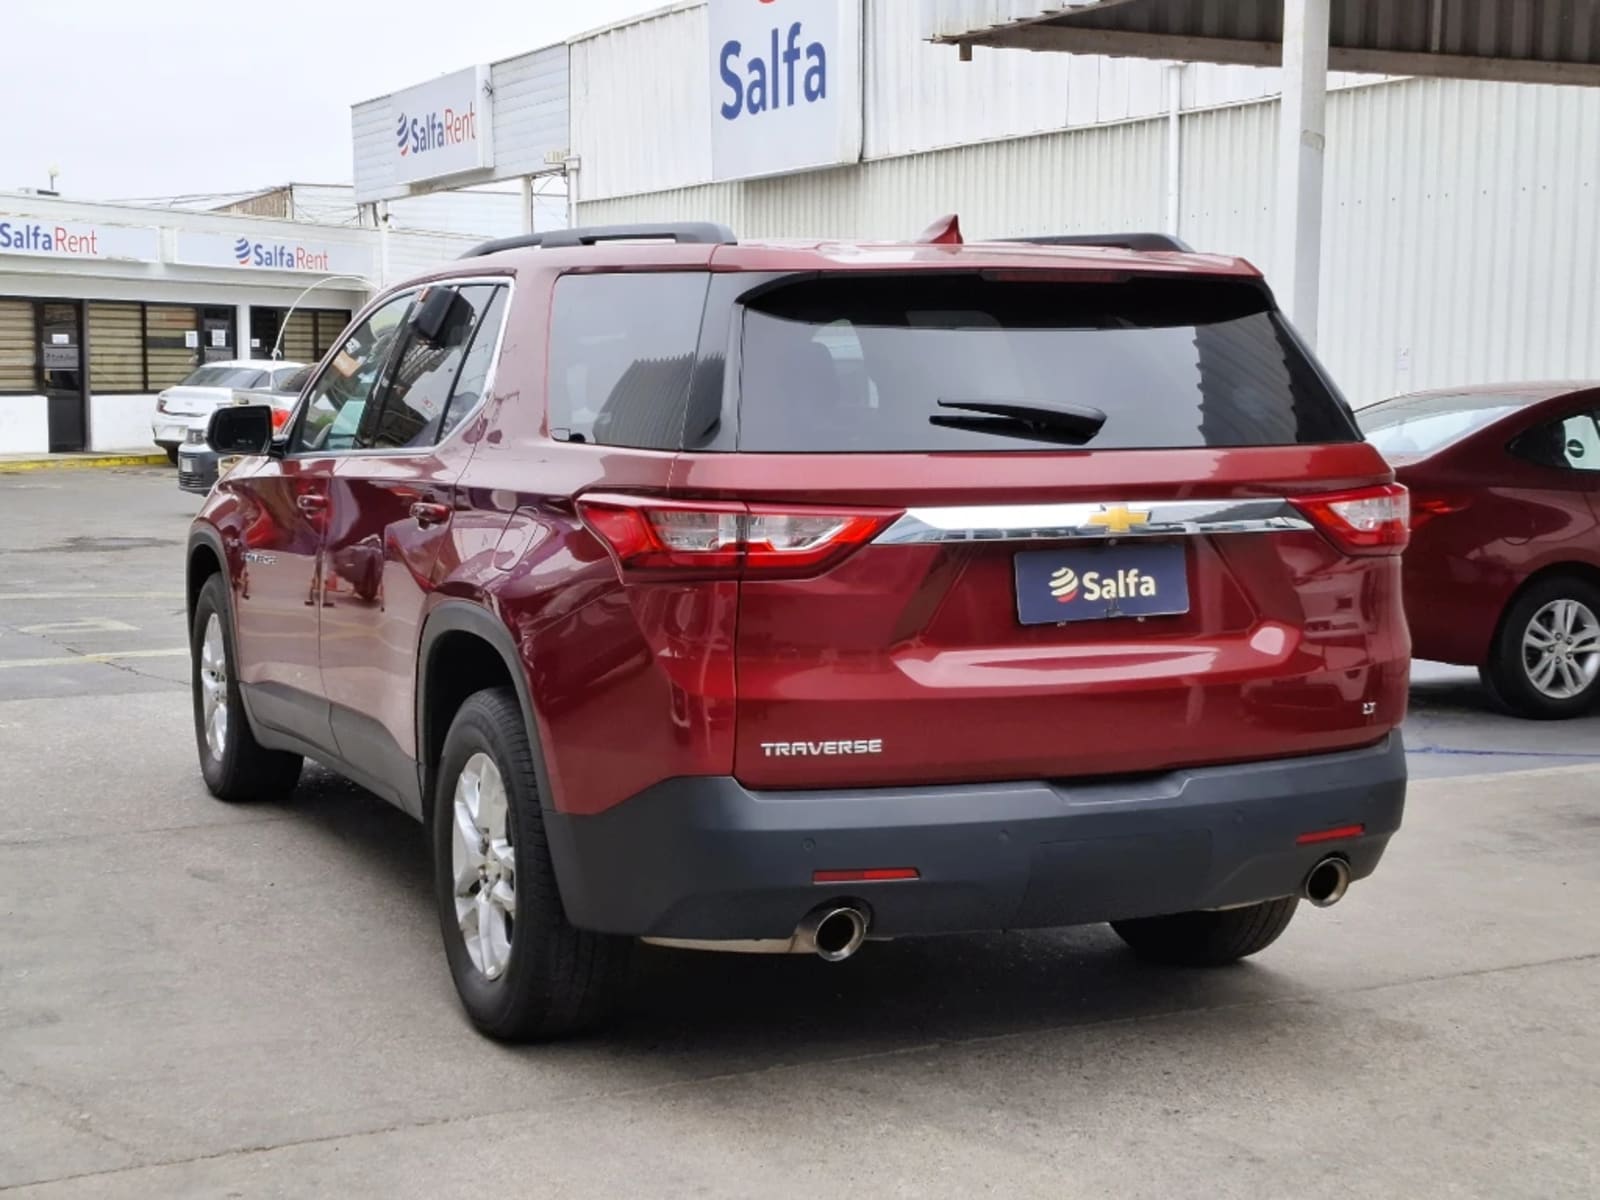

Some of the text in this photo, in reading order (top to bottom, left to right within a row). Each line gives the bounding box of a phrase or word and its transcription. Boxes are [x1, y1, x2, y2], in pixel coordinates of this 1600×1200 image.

[719, 21, 827, 121] Salfa
[411, 101, 475, 153] SalfaRent
[0, 222, 98, 254] SalfaRent
[254, 243, 328, 271] SalfaRent
[1082, 568, 1156, 601] Salfa
[760, 738, 883, 757] TRAVERSE
